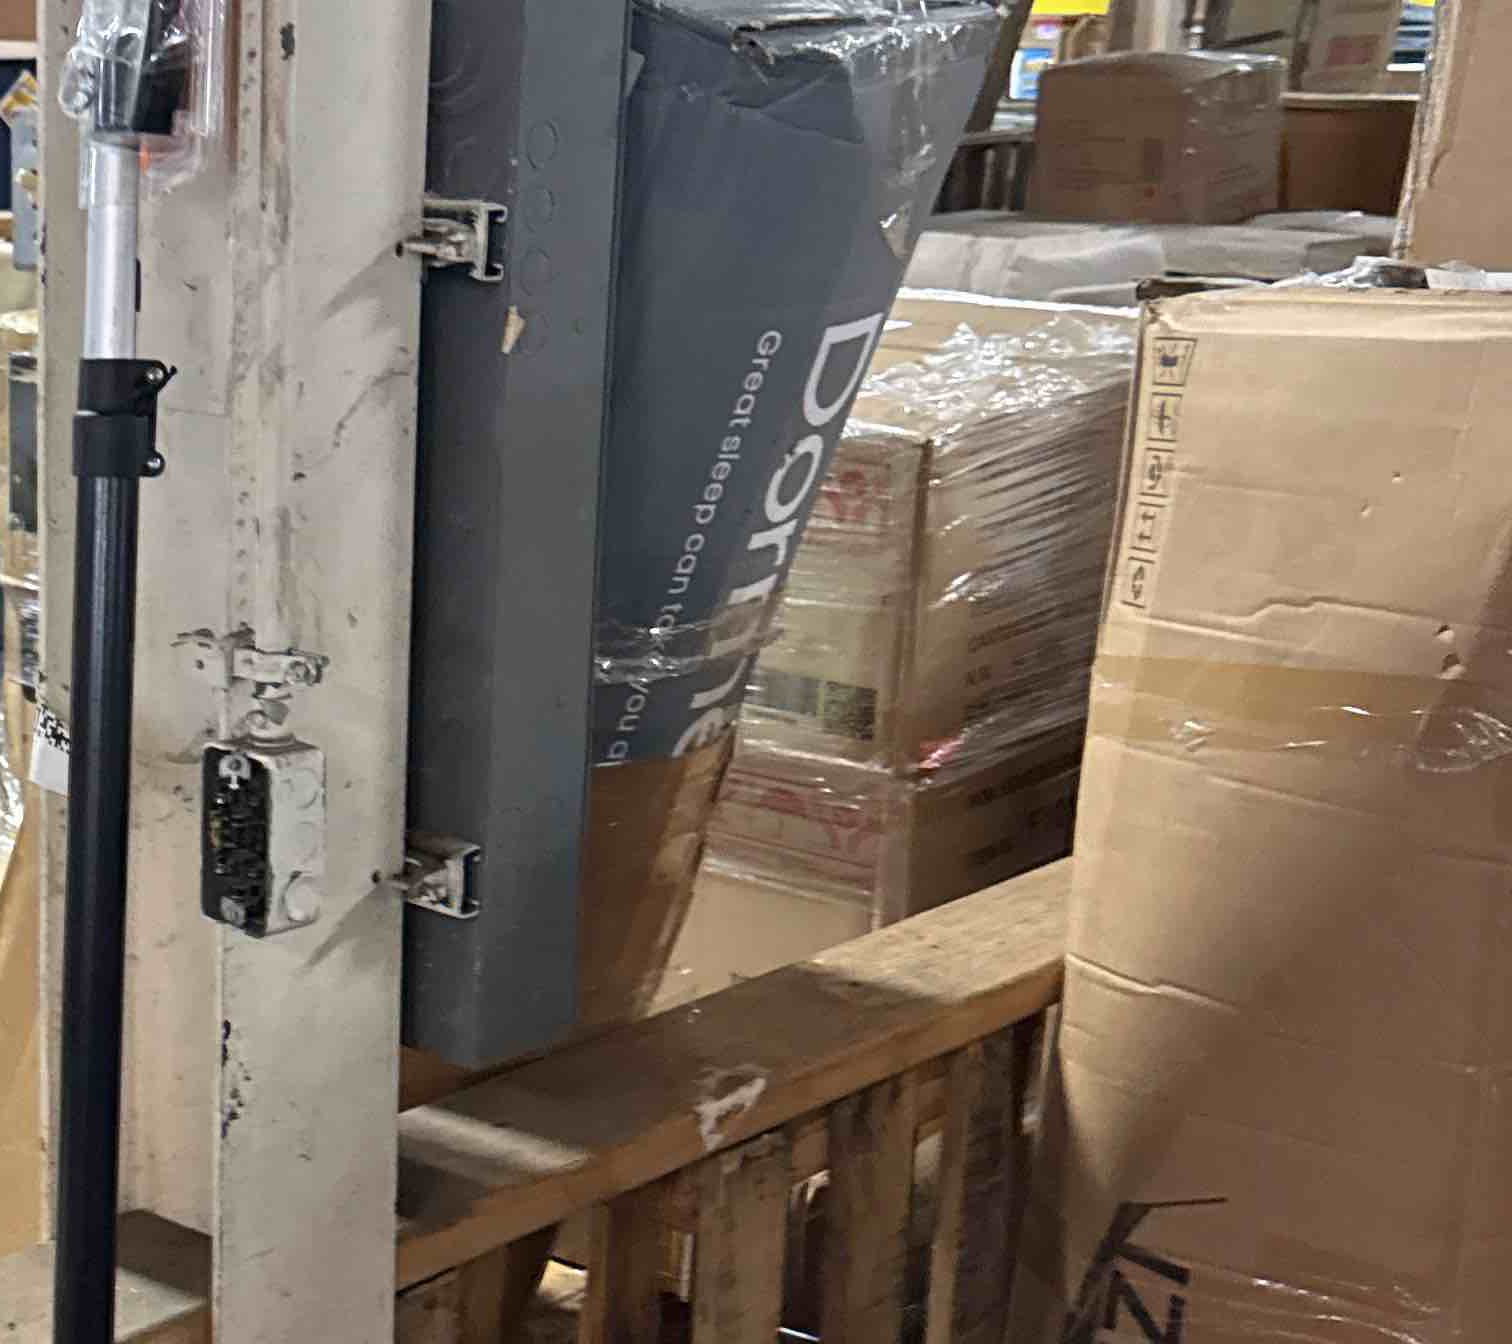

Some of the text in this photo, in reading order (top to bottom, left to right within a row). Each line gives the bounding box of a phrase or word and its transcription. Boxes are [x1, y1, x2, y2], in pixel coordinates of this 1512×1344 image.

[729, 330, 782, 427] Great
[693, 436, 742, 525] sleep
[667, 533, 705, 599] can
[617, 680, 649, 731] you
